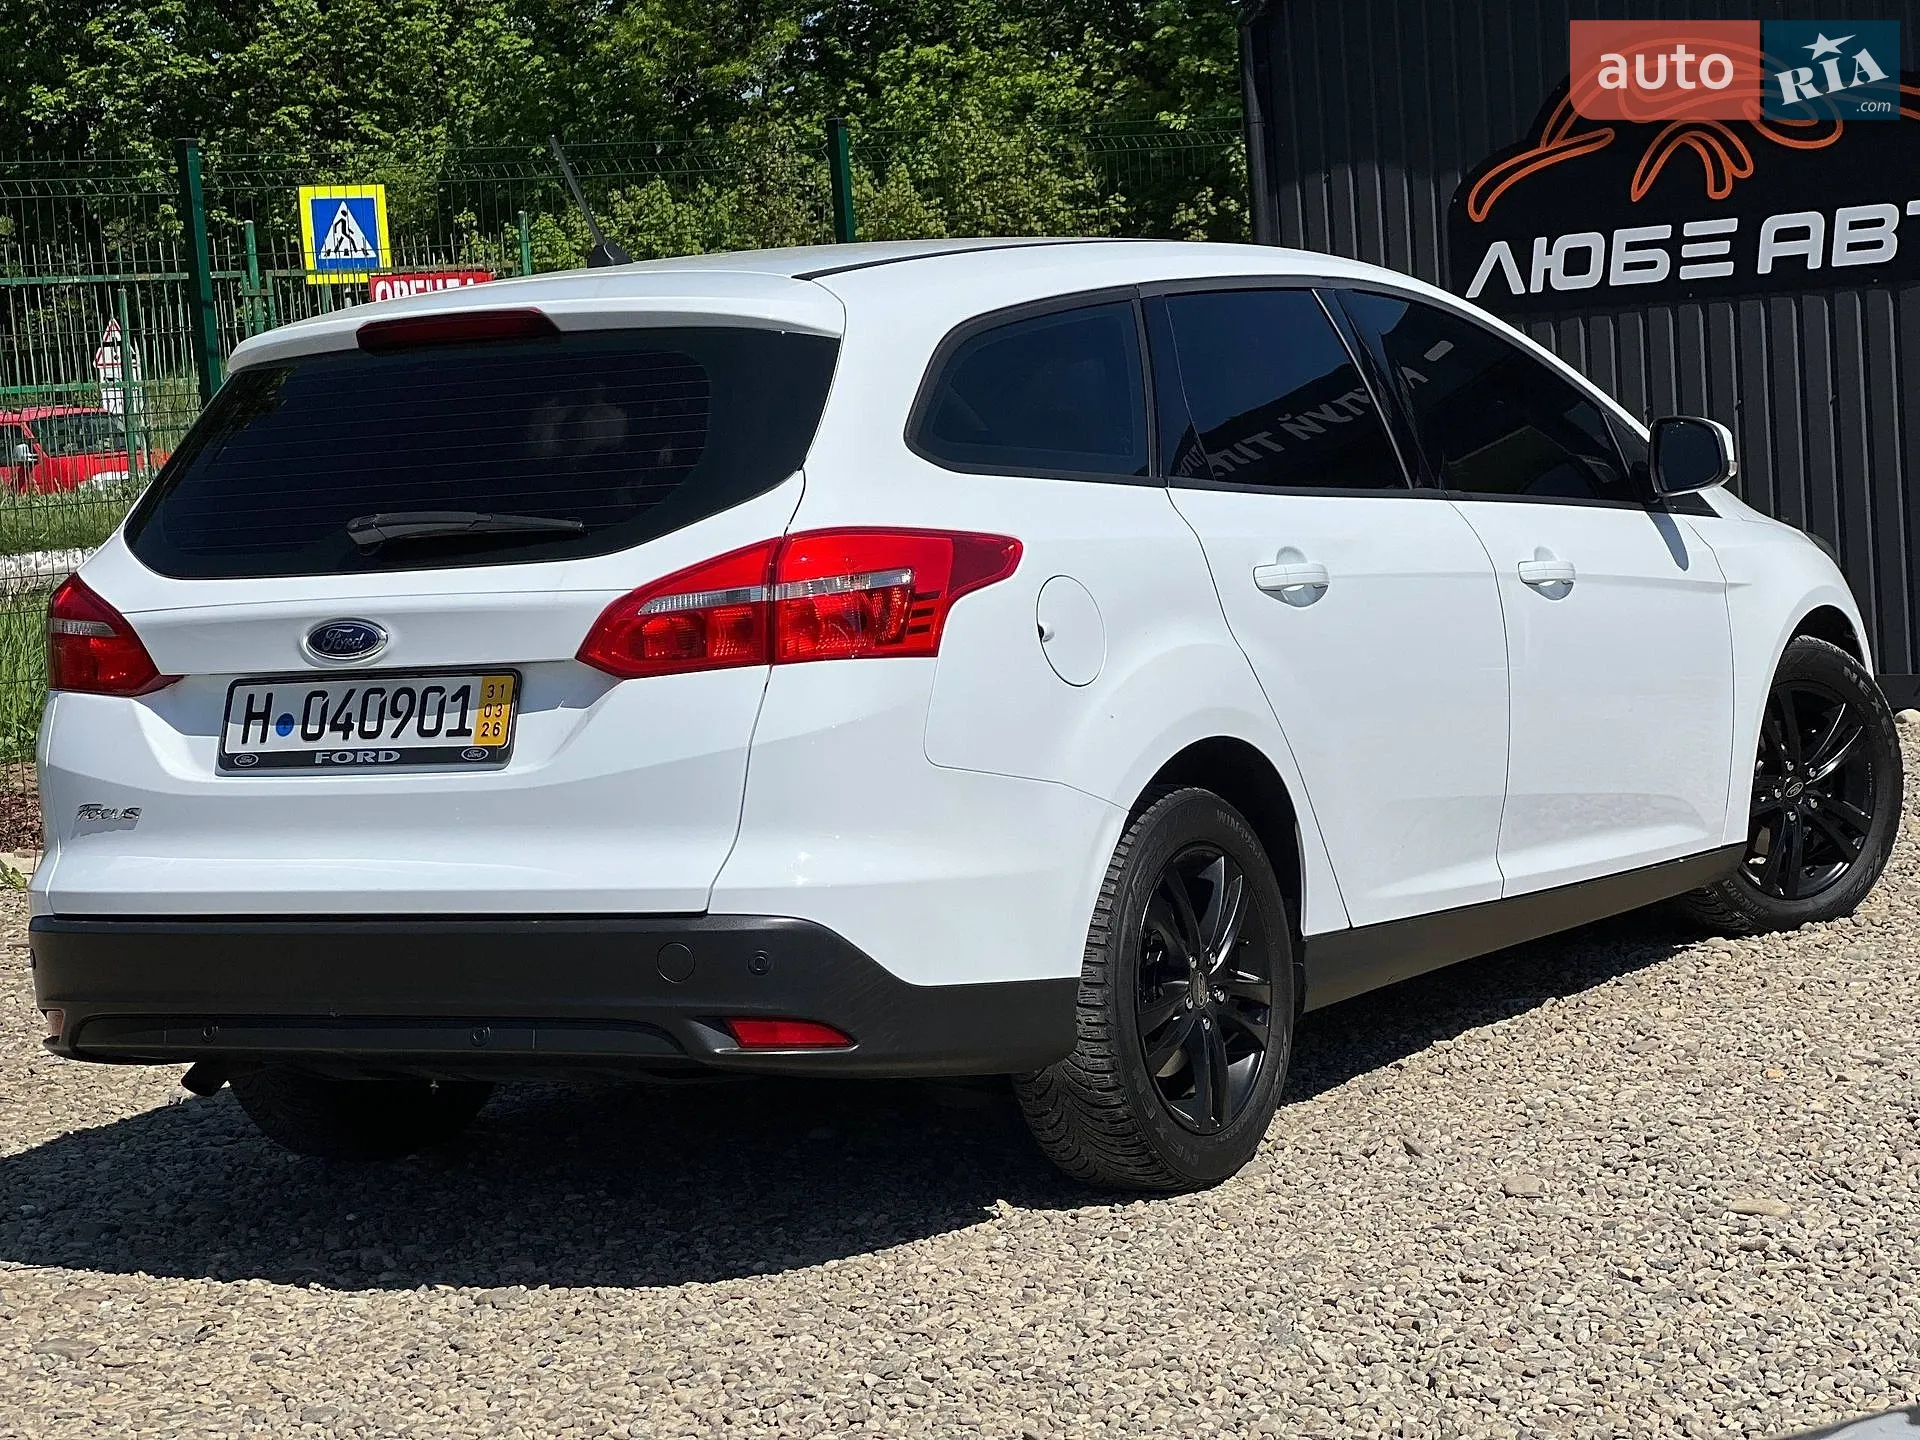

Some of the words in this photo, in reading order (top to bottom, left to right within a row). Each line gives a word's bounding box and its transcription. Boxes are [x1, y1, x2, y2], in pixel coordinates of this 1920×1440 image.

[1465, 217, 1738, 298] ЛЮБЕ
[1757, 200, 1920, 275] АВ
[321, 628, 365, 651] Ford
[487, 684, 505, 699] 31
[241, 692, 274, 744] H
[300, 684, 473, 742] 040901
[484, 703, 503, 718] 03
[481, 721, 501, 737] 26
[315, 750, 400, 764] FORD
